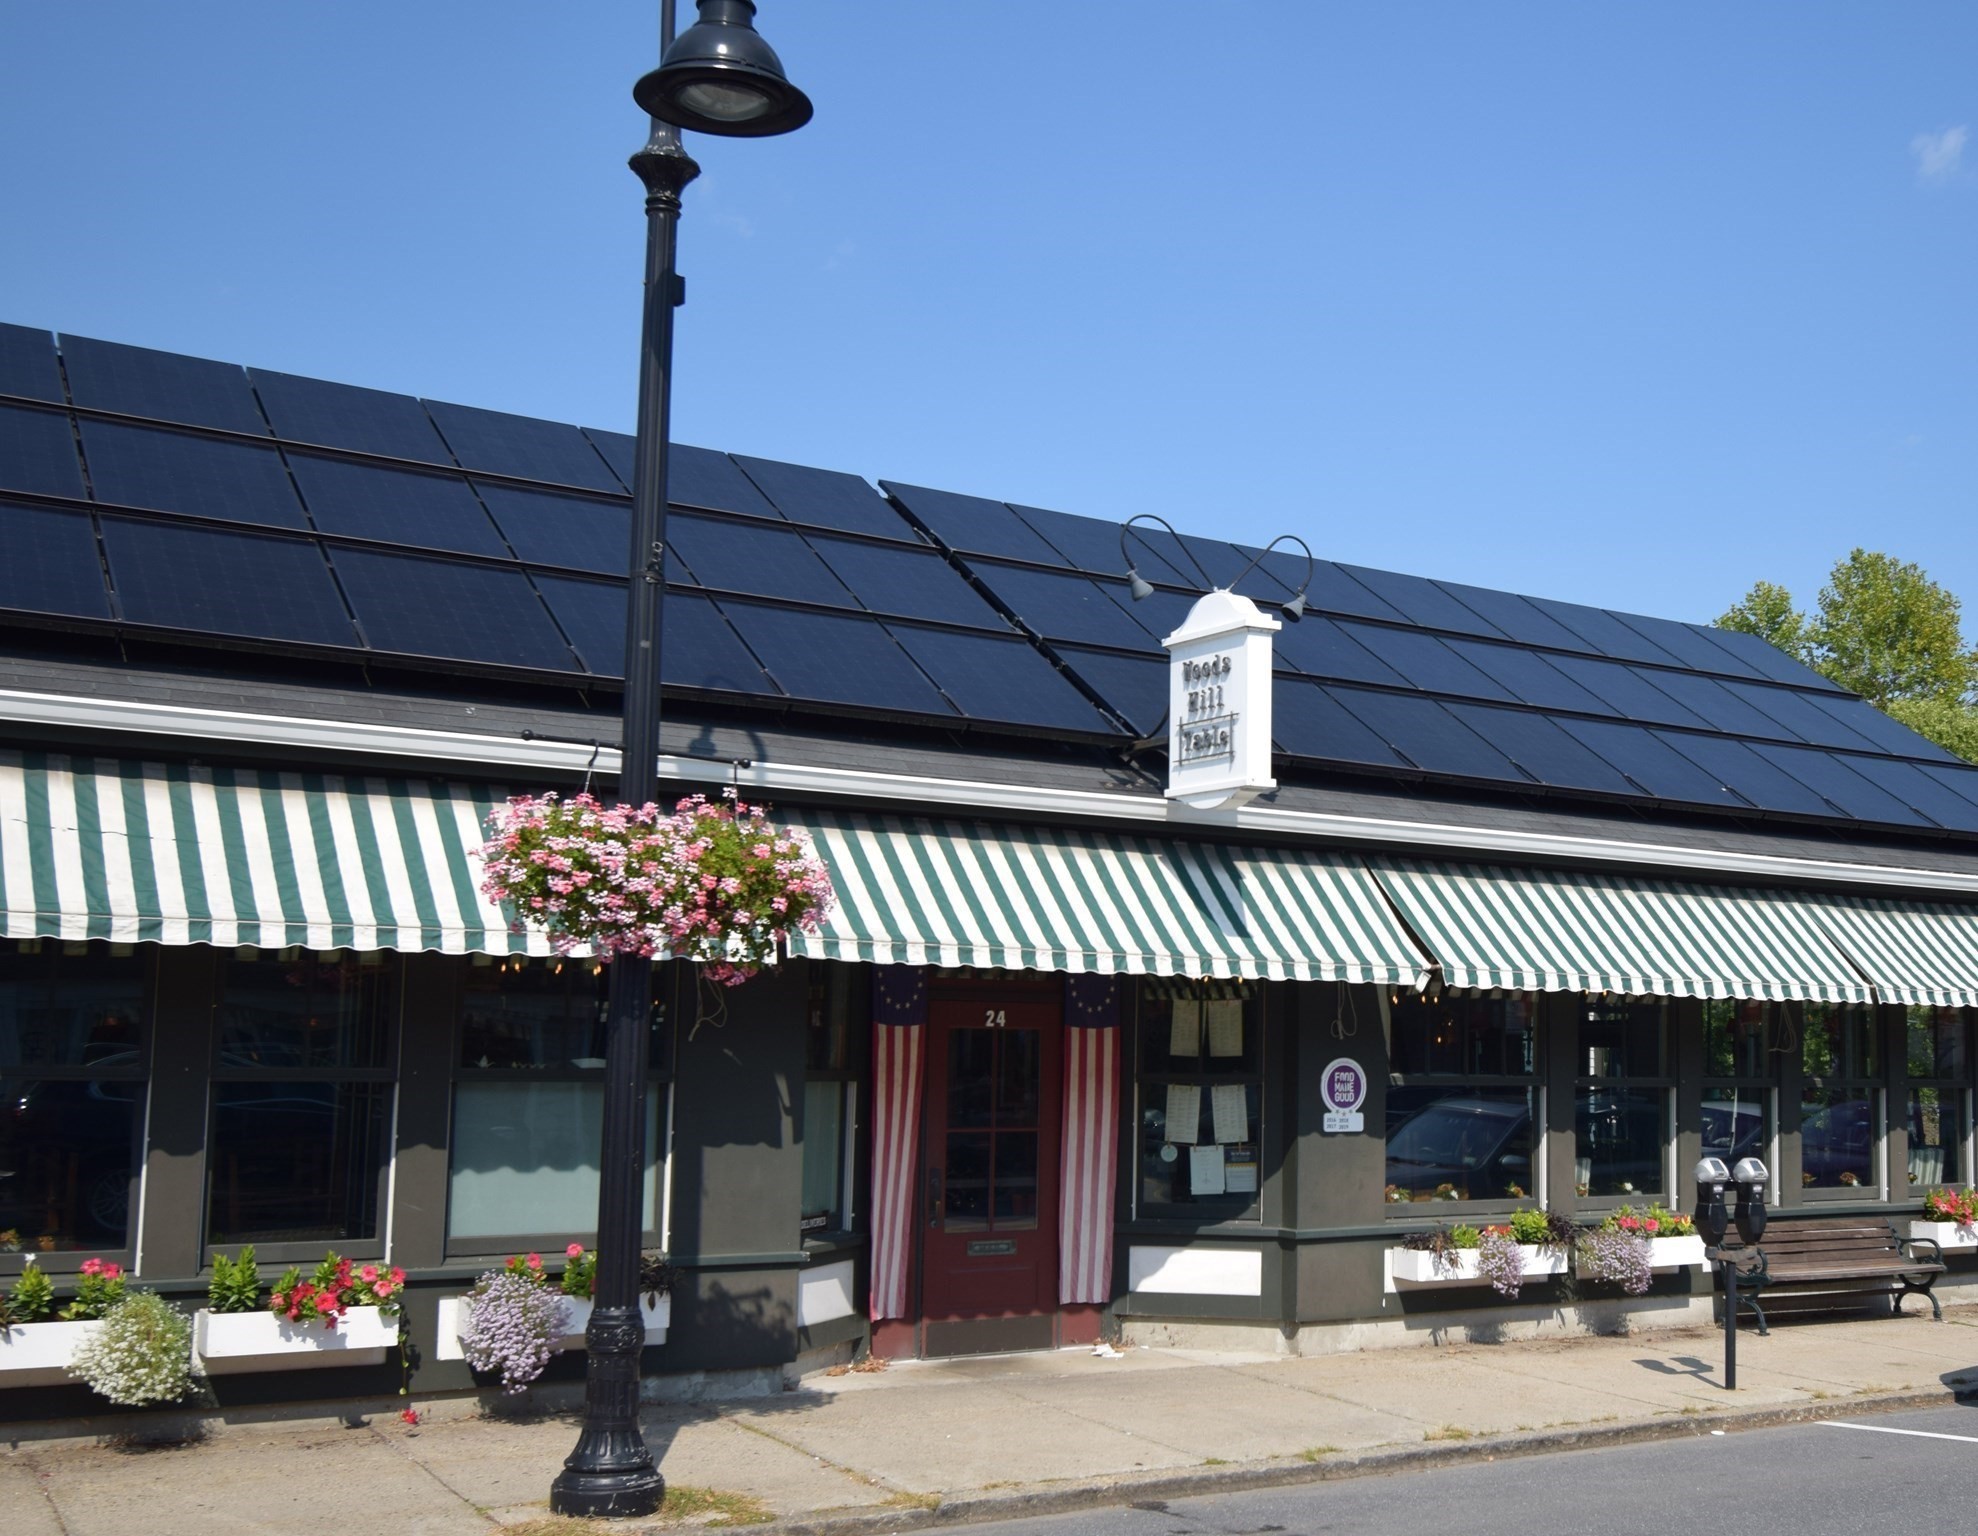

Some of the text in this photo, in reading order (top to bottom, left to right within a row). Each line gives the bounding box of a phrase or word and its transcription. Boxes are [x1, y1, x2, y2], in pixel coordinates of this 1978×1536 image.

[1182, 654, 1231, 682] Woods
[1184, 725, 1229, 752] Table
[985, 1010, 1005, 1027] 24
[1334, 1072, 1355, 1081] FOOD
[1334, 1092, 1355, 1102] GOOD
